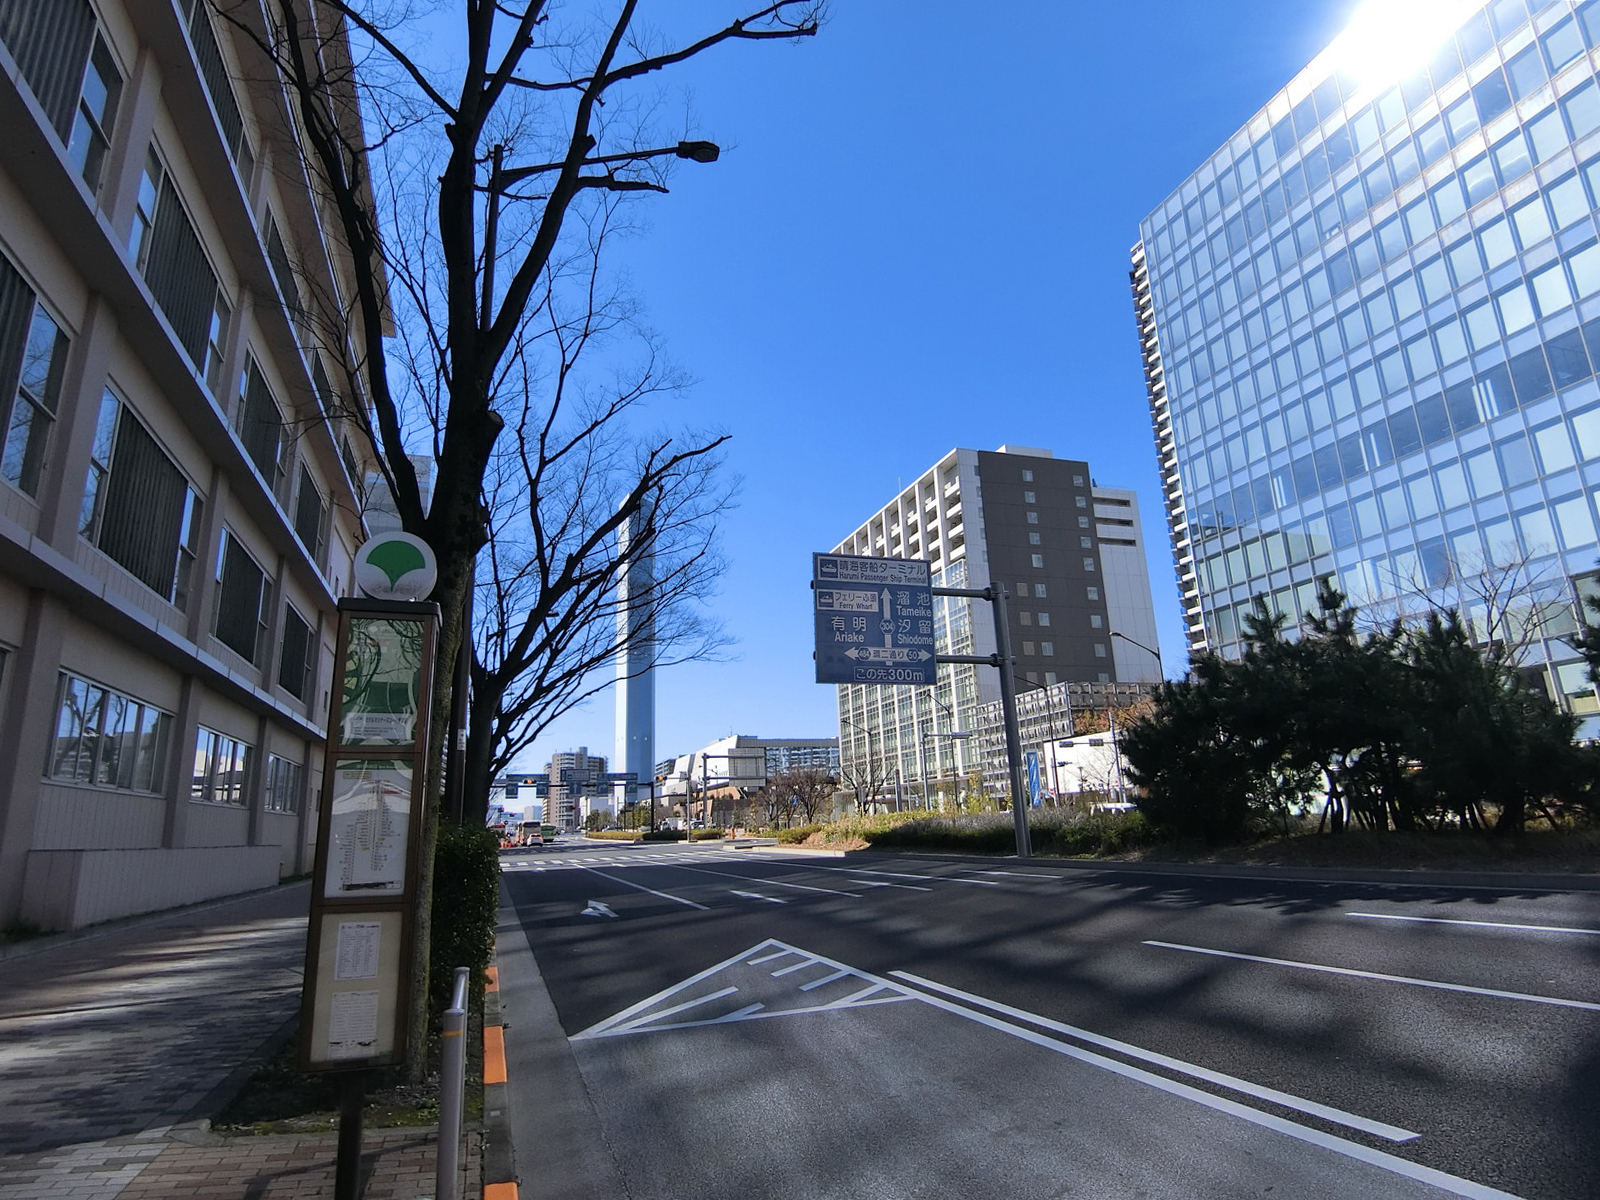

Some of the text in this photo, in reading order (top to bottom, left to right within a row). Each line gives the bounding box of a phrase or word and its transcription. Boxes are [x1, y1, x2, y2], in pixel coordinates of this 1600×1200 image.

[839, 560, 926, 575] 晴海客船ターミナル
[839, 571, 927, 584] Harumi Passenger Ship Terminal
[835, 591, 877, 603] フェリーふ頭
[896, 590, 931, 605] 溜池
[840, 602, 873, 610] Ferry Wharf
[896, 605, 932, 617] Tameike
[831, 615, 867, 631] 有明
[881, 622, 894, 631] 304
[897, 619, 931, 634] 汐留
[834, 631, 865, 643] Ariake
[897, 633, 934, 645] Shiodome
[873, 649, 904, 660] 環二通り
[908, 651, 918, 659] 50
[856, 668, 923, 681] この先300m
